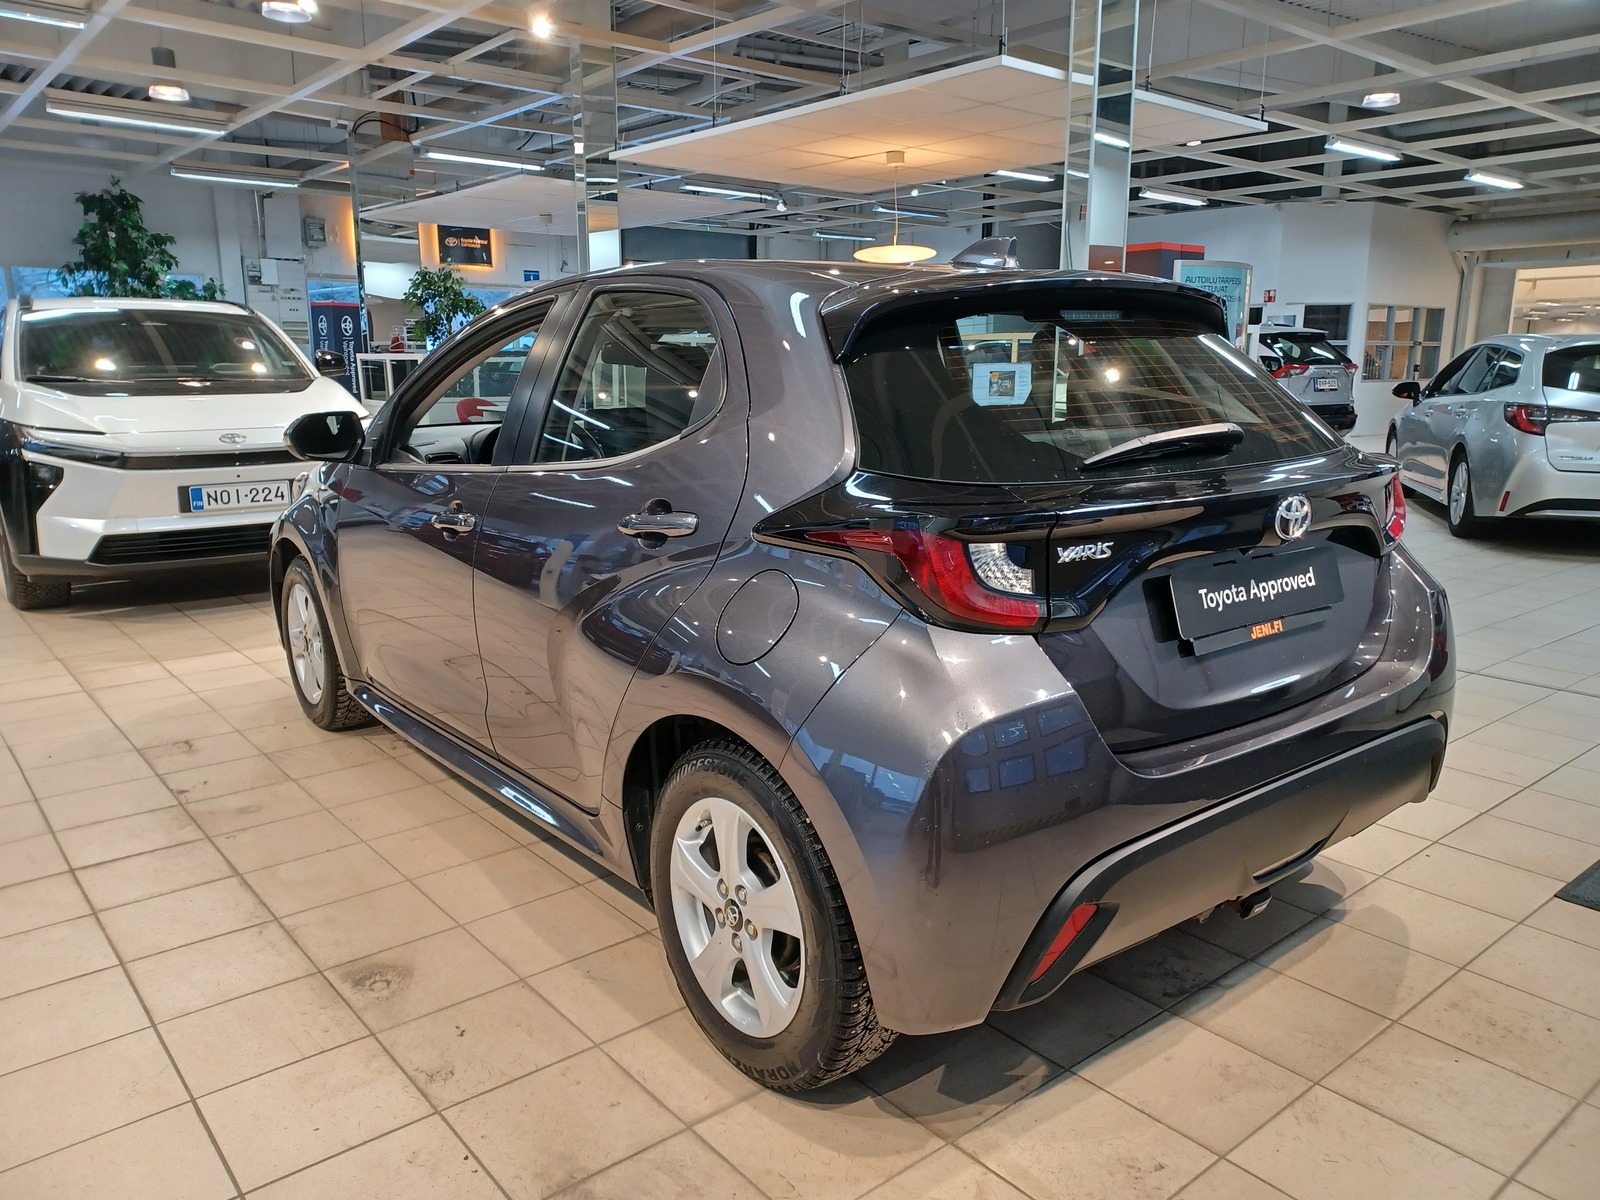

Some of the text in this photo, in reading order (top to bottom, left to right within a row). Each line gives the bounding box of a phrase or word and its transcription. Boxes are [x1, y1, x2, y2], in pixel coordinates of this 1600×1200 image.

[350, 362, 358, 394] Approved
[206, 486, 286, 507] NOI-224
[1057, 541, 1115, 564] YARIS
[1198, 566, 1316, 612] Toyota Approved
[1250, 620, 1283, 640] JENI.FI
